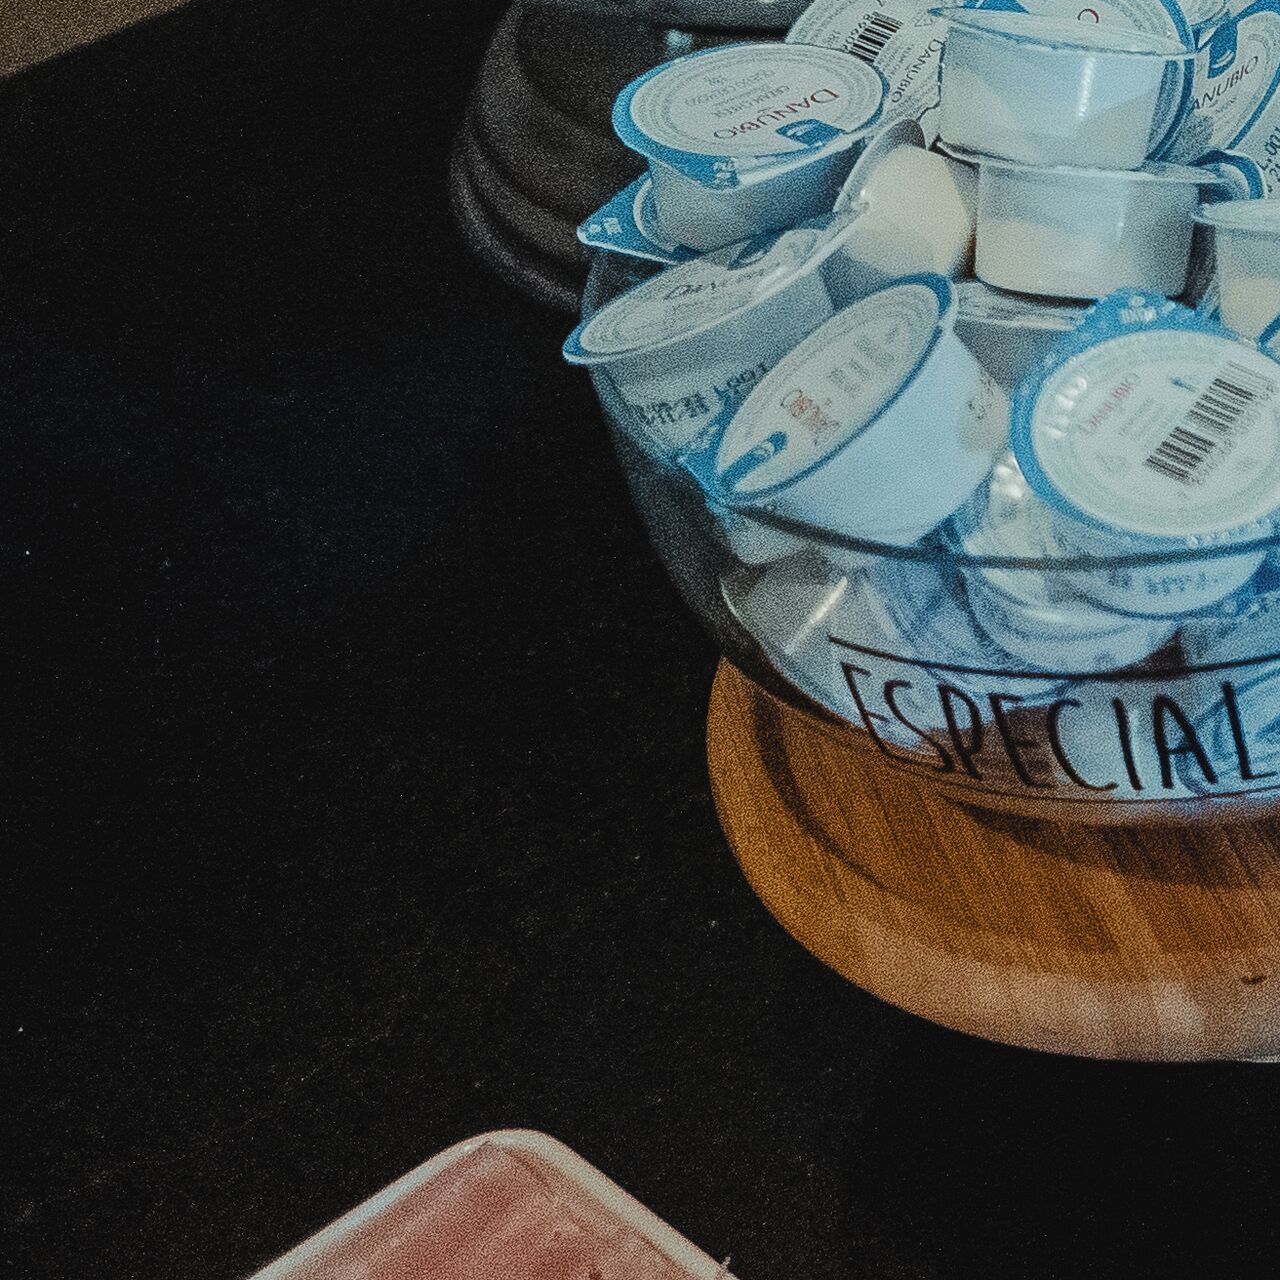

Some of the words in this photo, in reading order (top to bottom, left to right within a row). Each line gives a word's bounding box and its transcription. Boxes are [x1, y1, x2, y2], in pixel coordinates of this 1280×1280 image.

[891, 38, 947, 103] DANUBIO
[1191, 54, 1259, 113] ANUBIO
[713, 88, 840, 140] DANUBIO
[840, 661, 1276, 790] ESPECIAL
